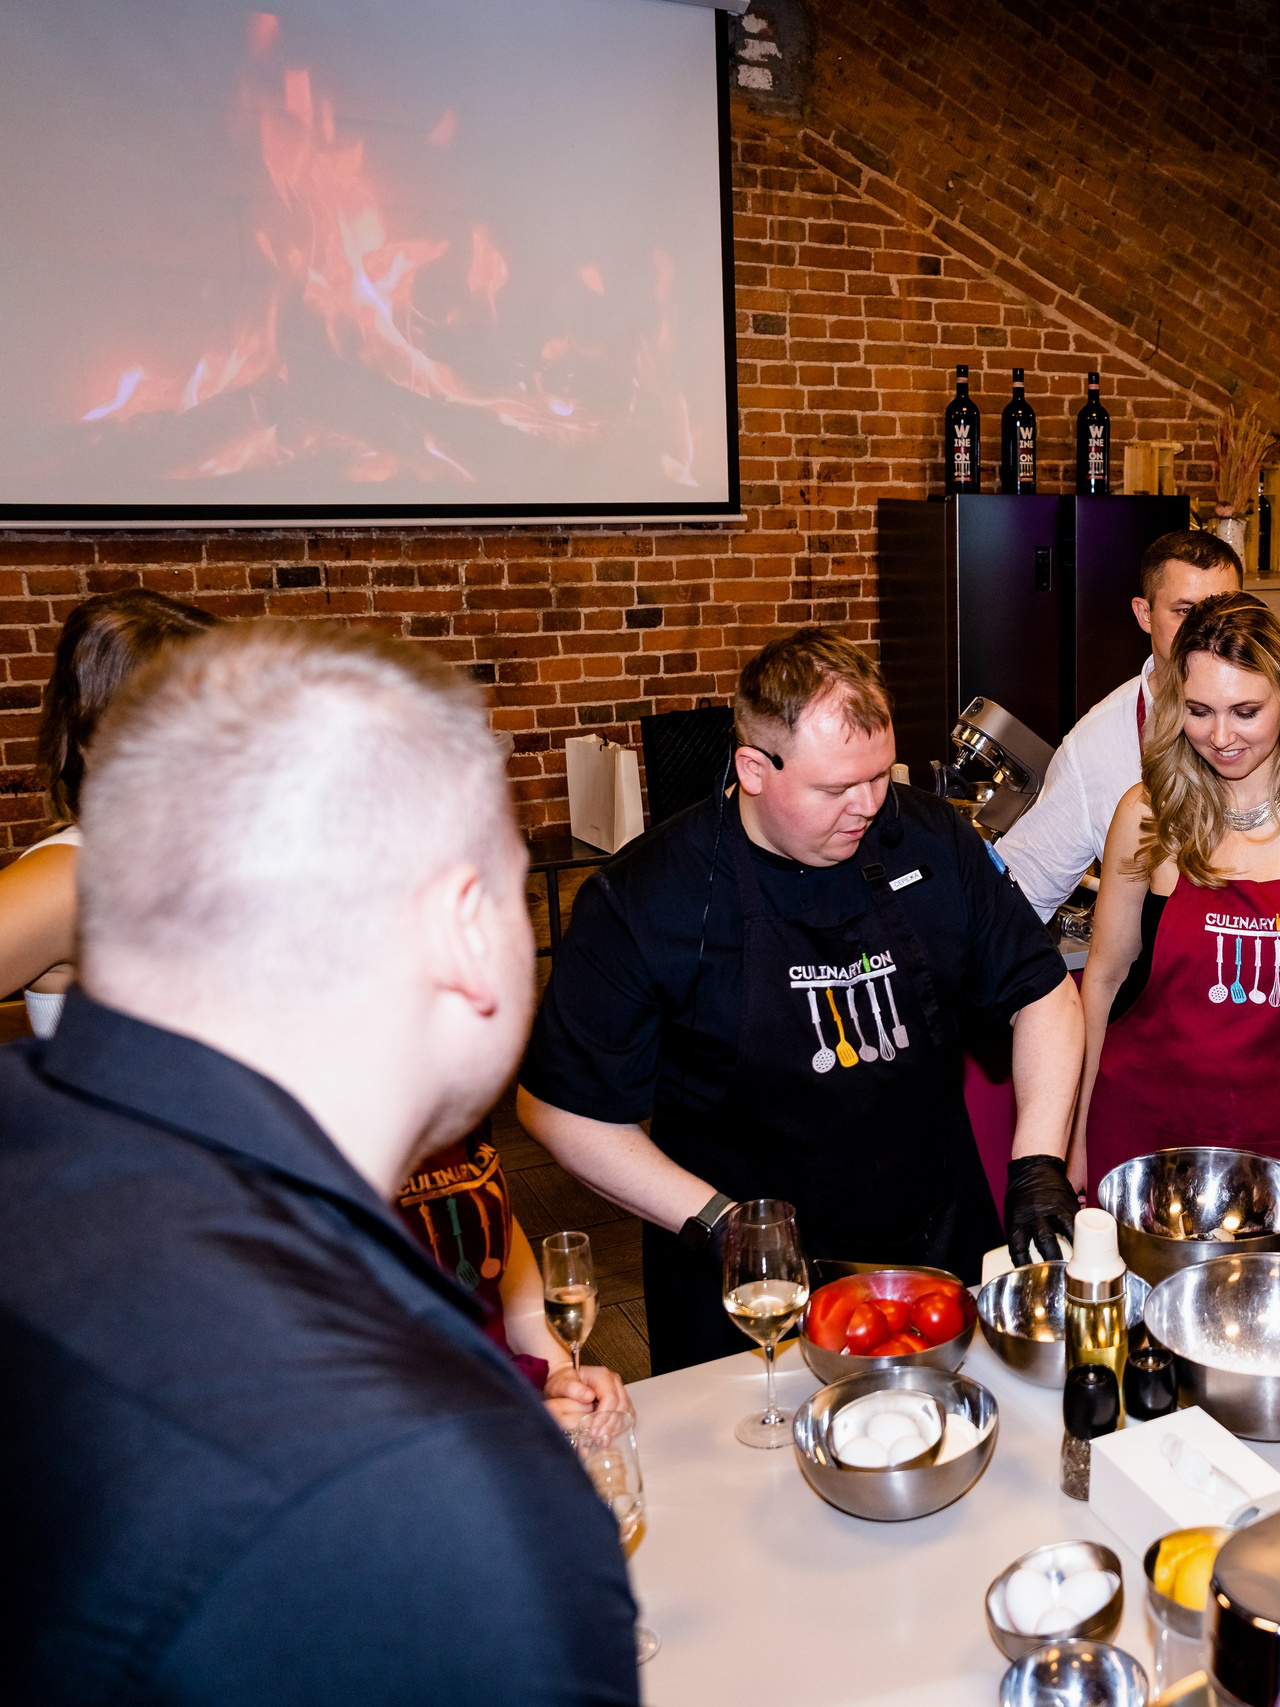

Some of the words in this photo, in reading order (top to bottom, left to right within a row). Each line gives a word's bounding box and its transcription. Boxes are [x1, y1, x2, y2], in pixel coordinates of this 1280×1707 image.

[954, 424, 970, 438] W
[1019, 426, 1033, 440] W
[1088, 425, 1104, 438] W
[954, 438, 971, 447] INE
[1019, 440, 1034, 449] INE
[1088, 439, 1104, 447] INE
[954, 452, 970, 461] ON
[1019, 453, 1033, 462] ON
[1088, 452, 1103, 460] ON
